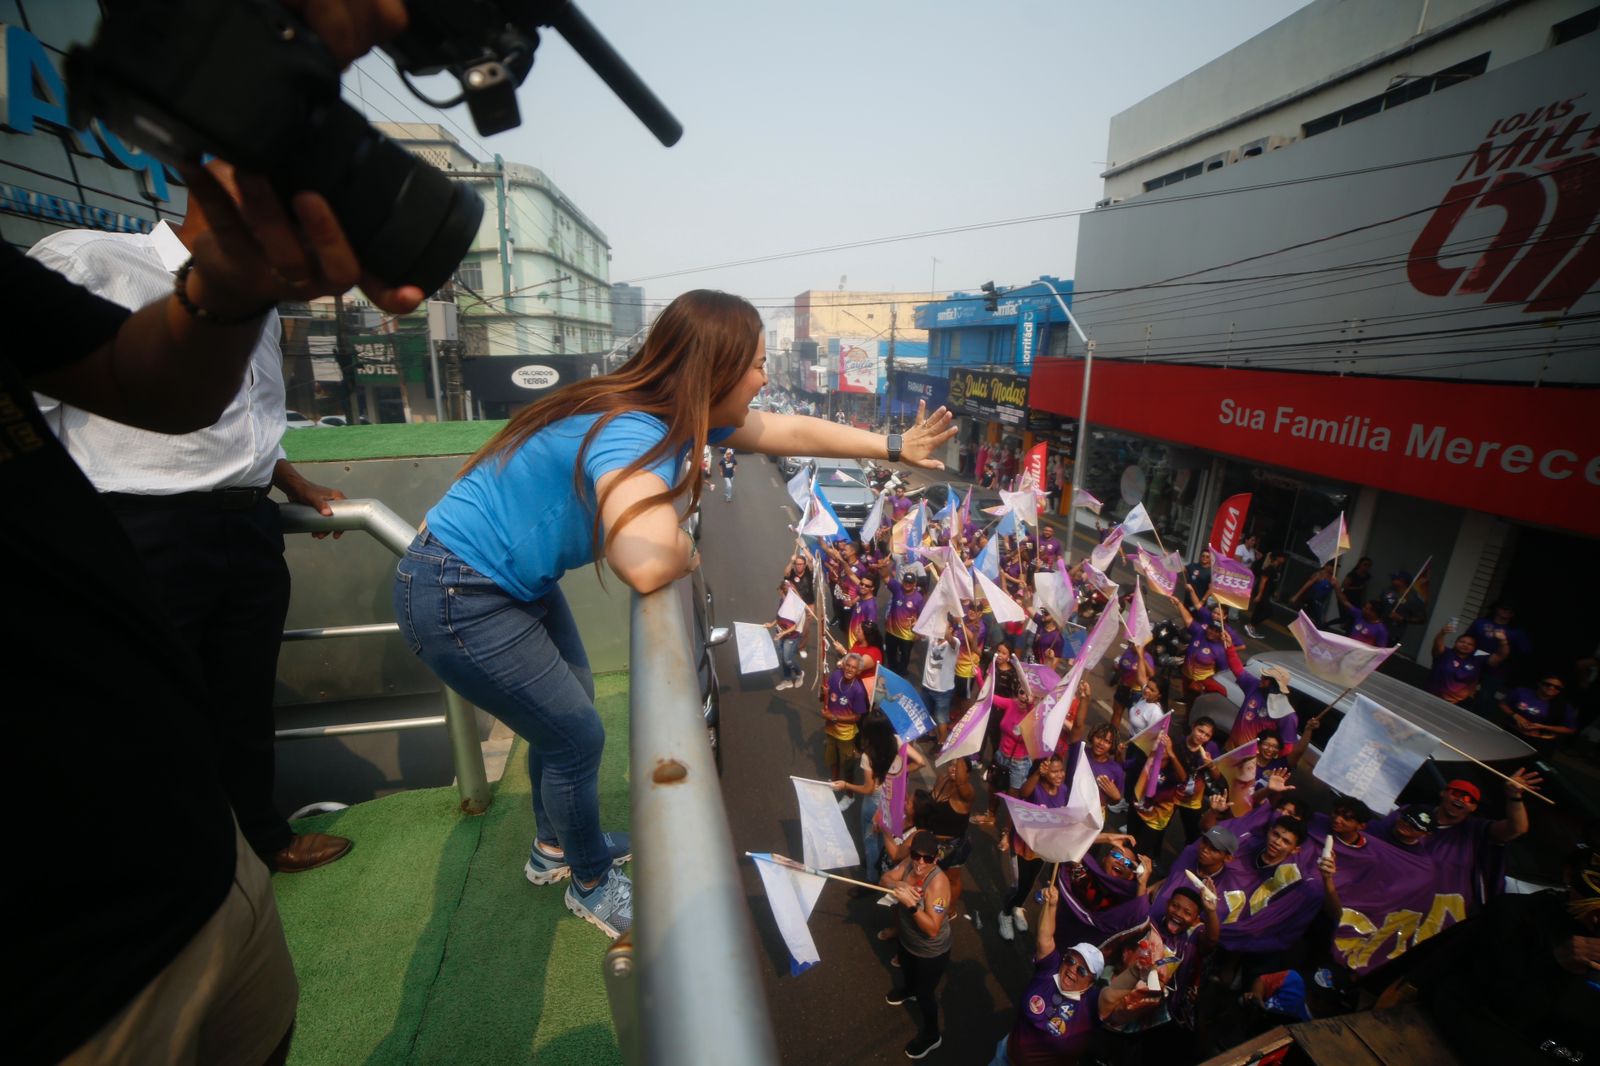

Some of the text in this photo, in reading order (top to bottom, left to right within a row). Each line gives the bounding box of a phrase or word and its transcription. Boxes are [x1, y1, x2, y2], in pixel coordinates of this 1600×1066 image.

[1486, 92, 1588, 138] LOJAS
[965, 374, 988, 398] Dulci
[990, 377, 1026, 407] Modas
[1218, 398, 1266, 431] Sua
[1273, 406, 1392, 452] Família
